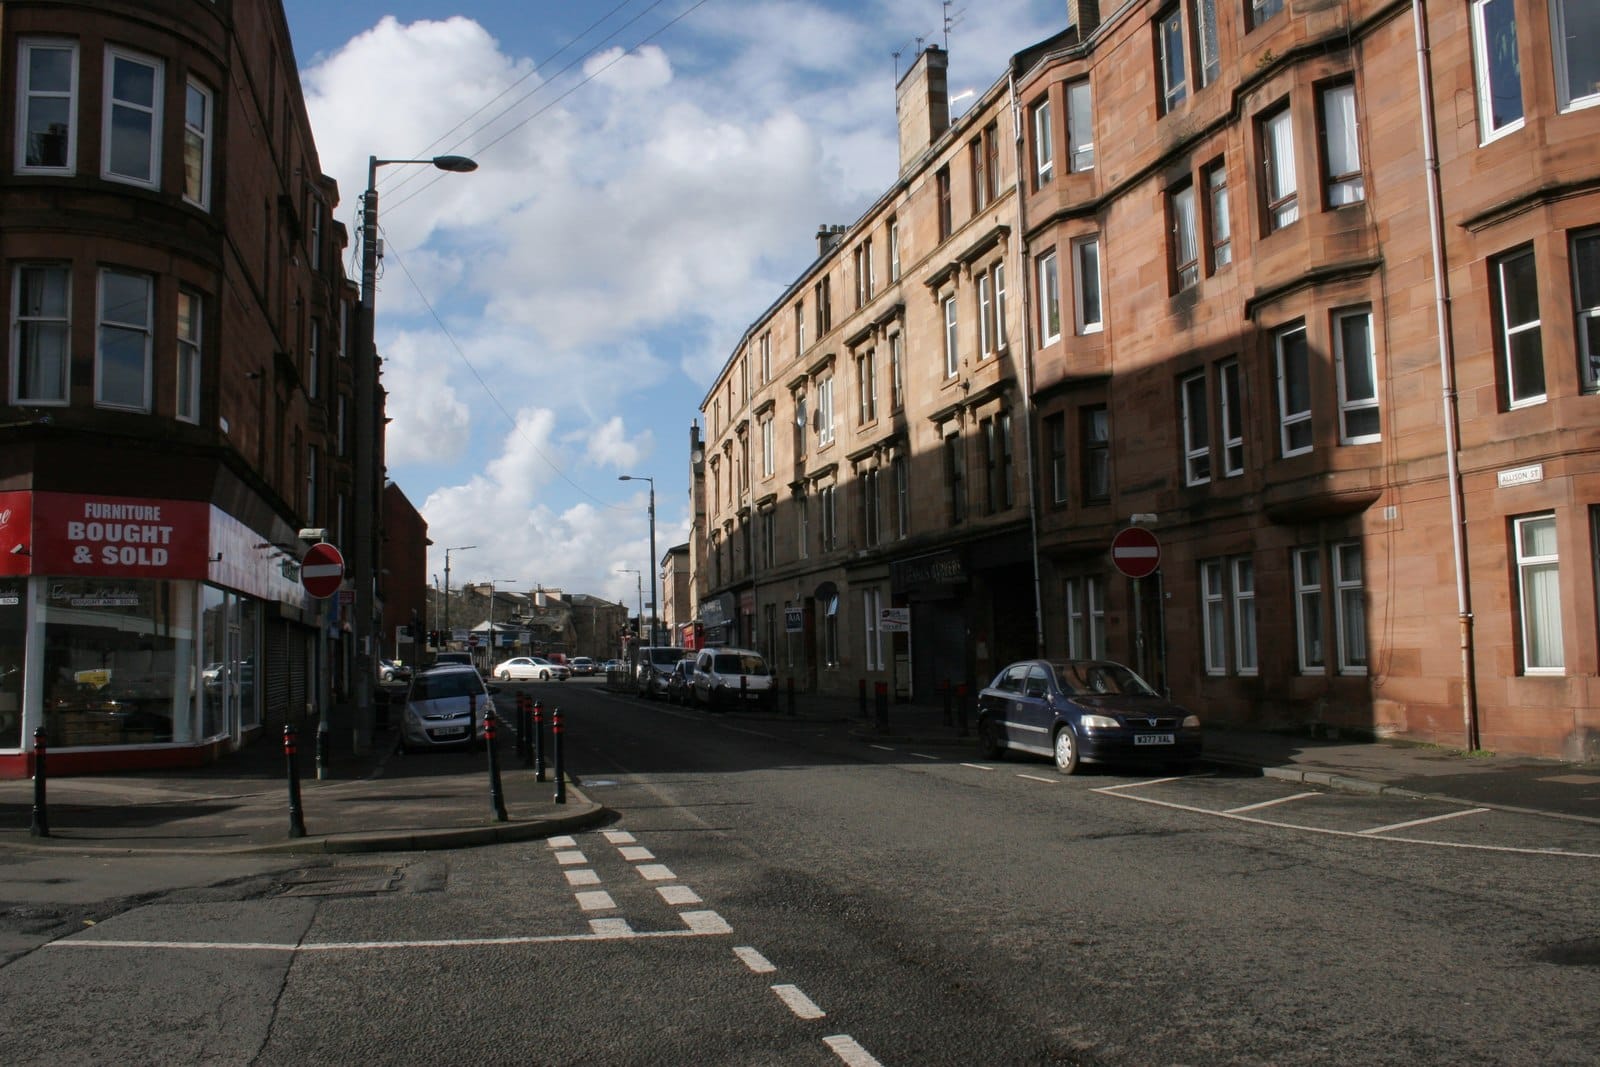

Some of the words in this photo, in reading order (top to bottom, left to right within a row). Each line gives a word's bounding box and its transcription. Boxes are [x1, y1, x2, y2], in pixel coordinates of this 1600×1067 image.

[1502, 471, 1528, 483] ALLISON
[1530, 469, 1539, 478] ST
[84, 502, 161, 521] FURNITURE
[67, 521, 173, 544] BOUGHT
[73, 545, 93, 564] &
[102, 546, 168, 566] SOLD
